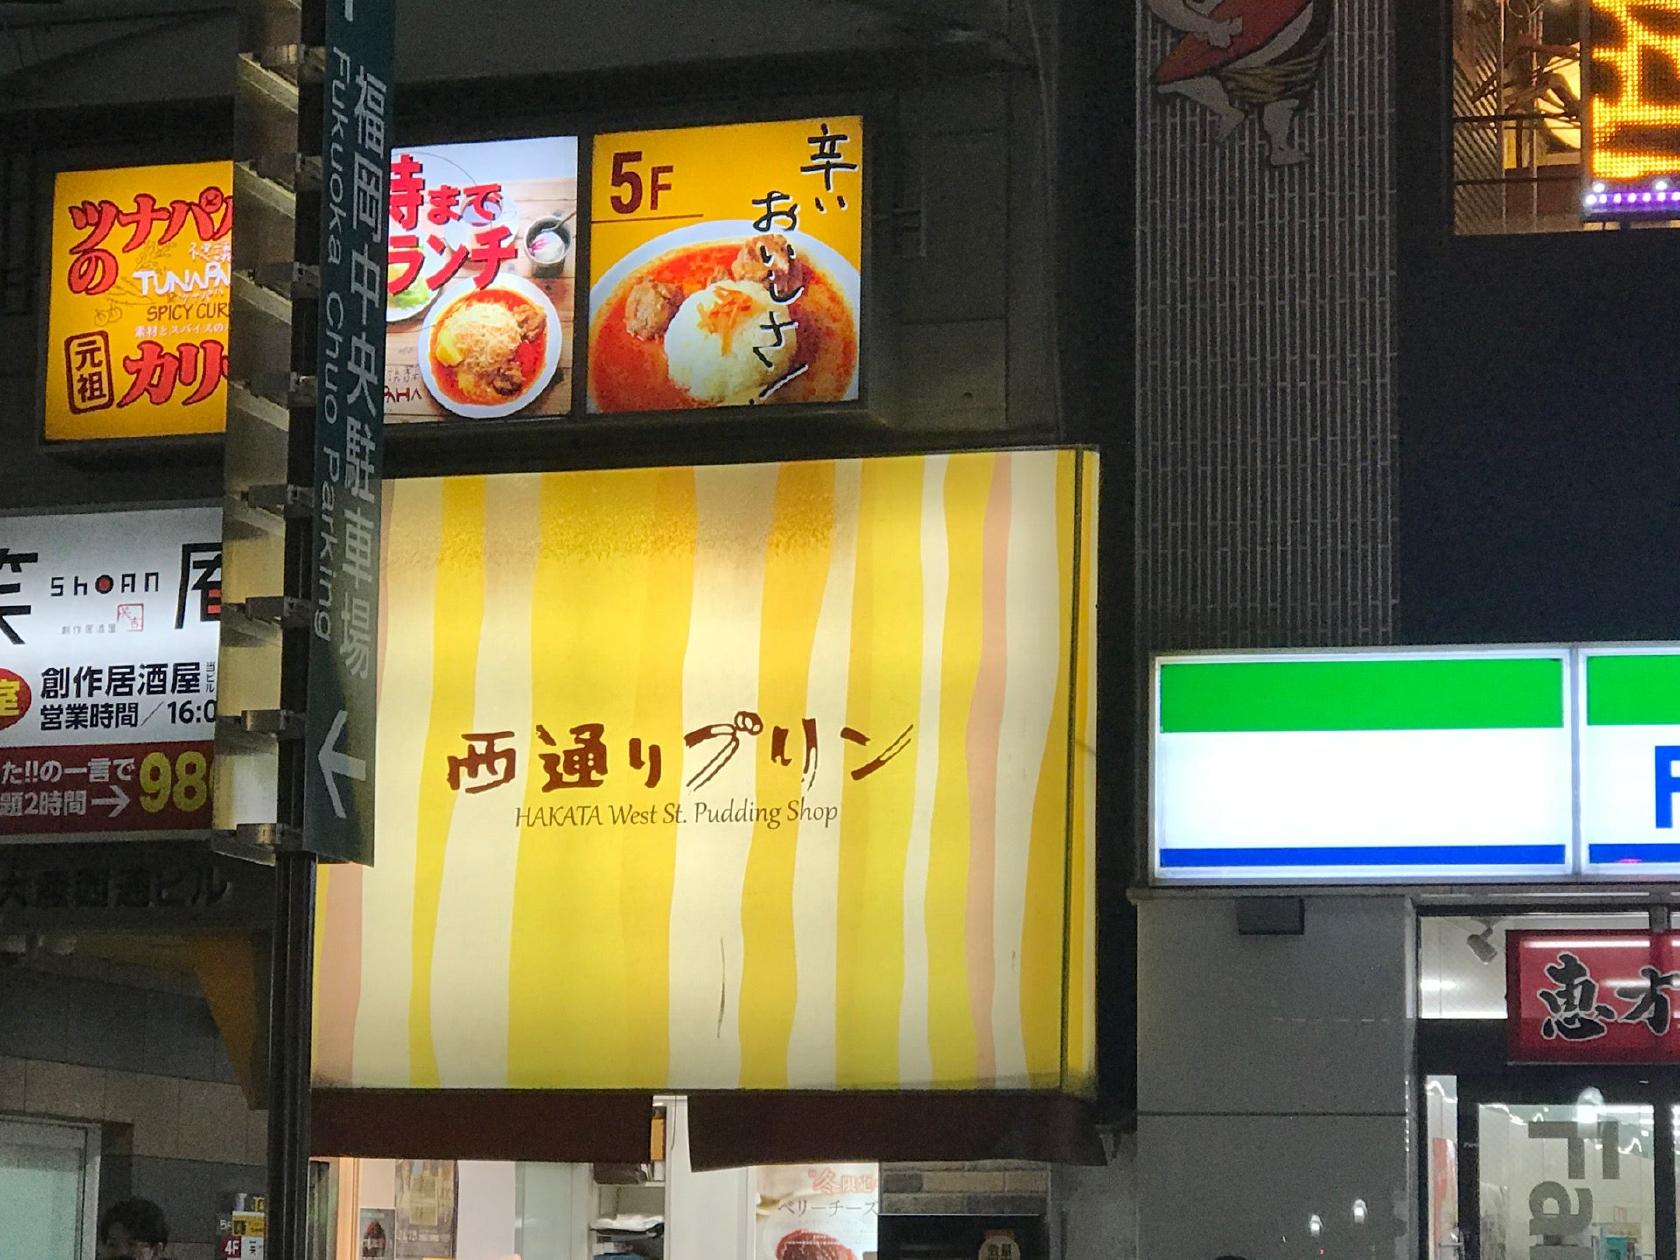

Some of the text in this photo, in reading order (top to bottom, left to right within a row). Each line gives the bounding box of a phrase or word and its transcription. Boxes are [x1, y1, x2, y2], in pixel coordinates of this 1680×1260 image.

[610, 150, 674, 214] 5F
[800, 122, 858, 212] 辛い
[67, 248, 119, 295] の
[387, 225, 519, 296] ランチ
[147, 303, 194, 321] SPICY
[314, 46, 350, 642] Fukuoka Chuo Parking
[75, 339, 107, 403] 元祖
[340, 65, 387, 680] 福岡中央駐車場
[40, 661, 201, 699] 創作居酒屋
[139, 751, 213, 813] 98
[447, 711, 914, 795] 西通りプリン
[515, 796, 838, 830] HAKATA West St. Pudding Shop
[224, 1239, 240, 1256] 4F
